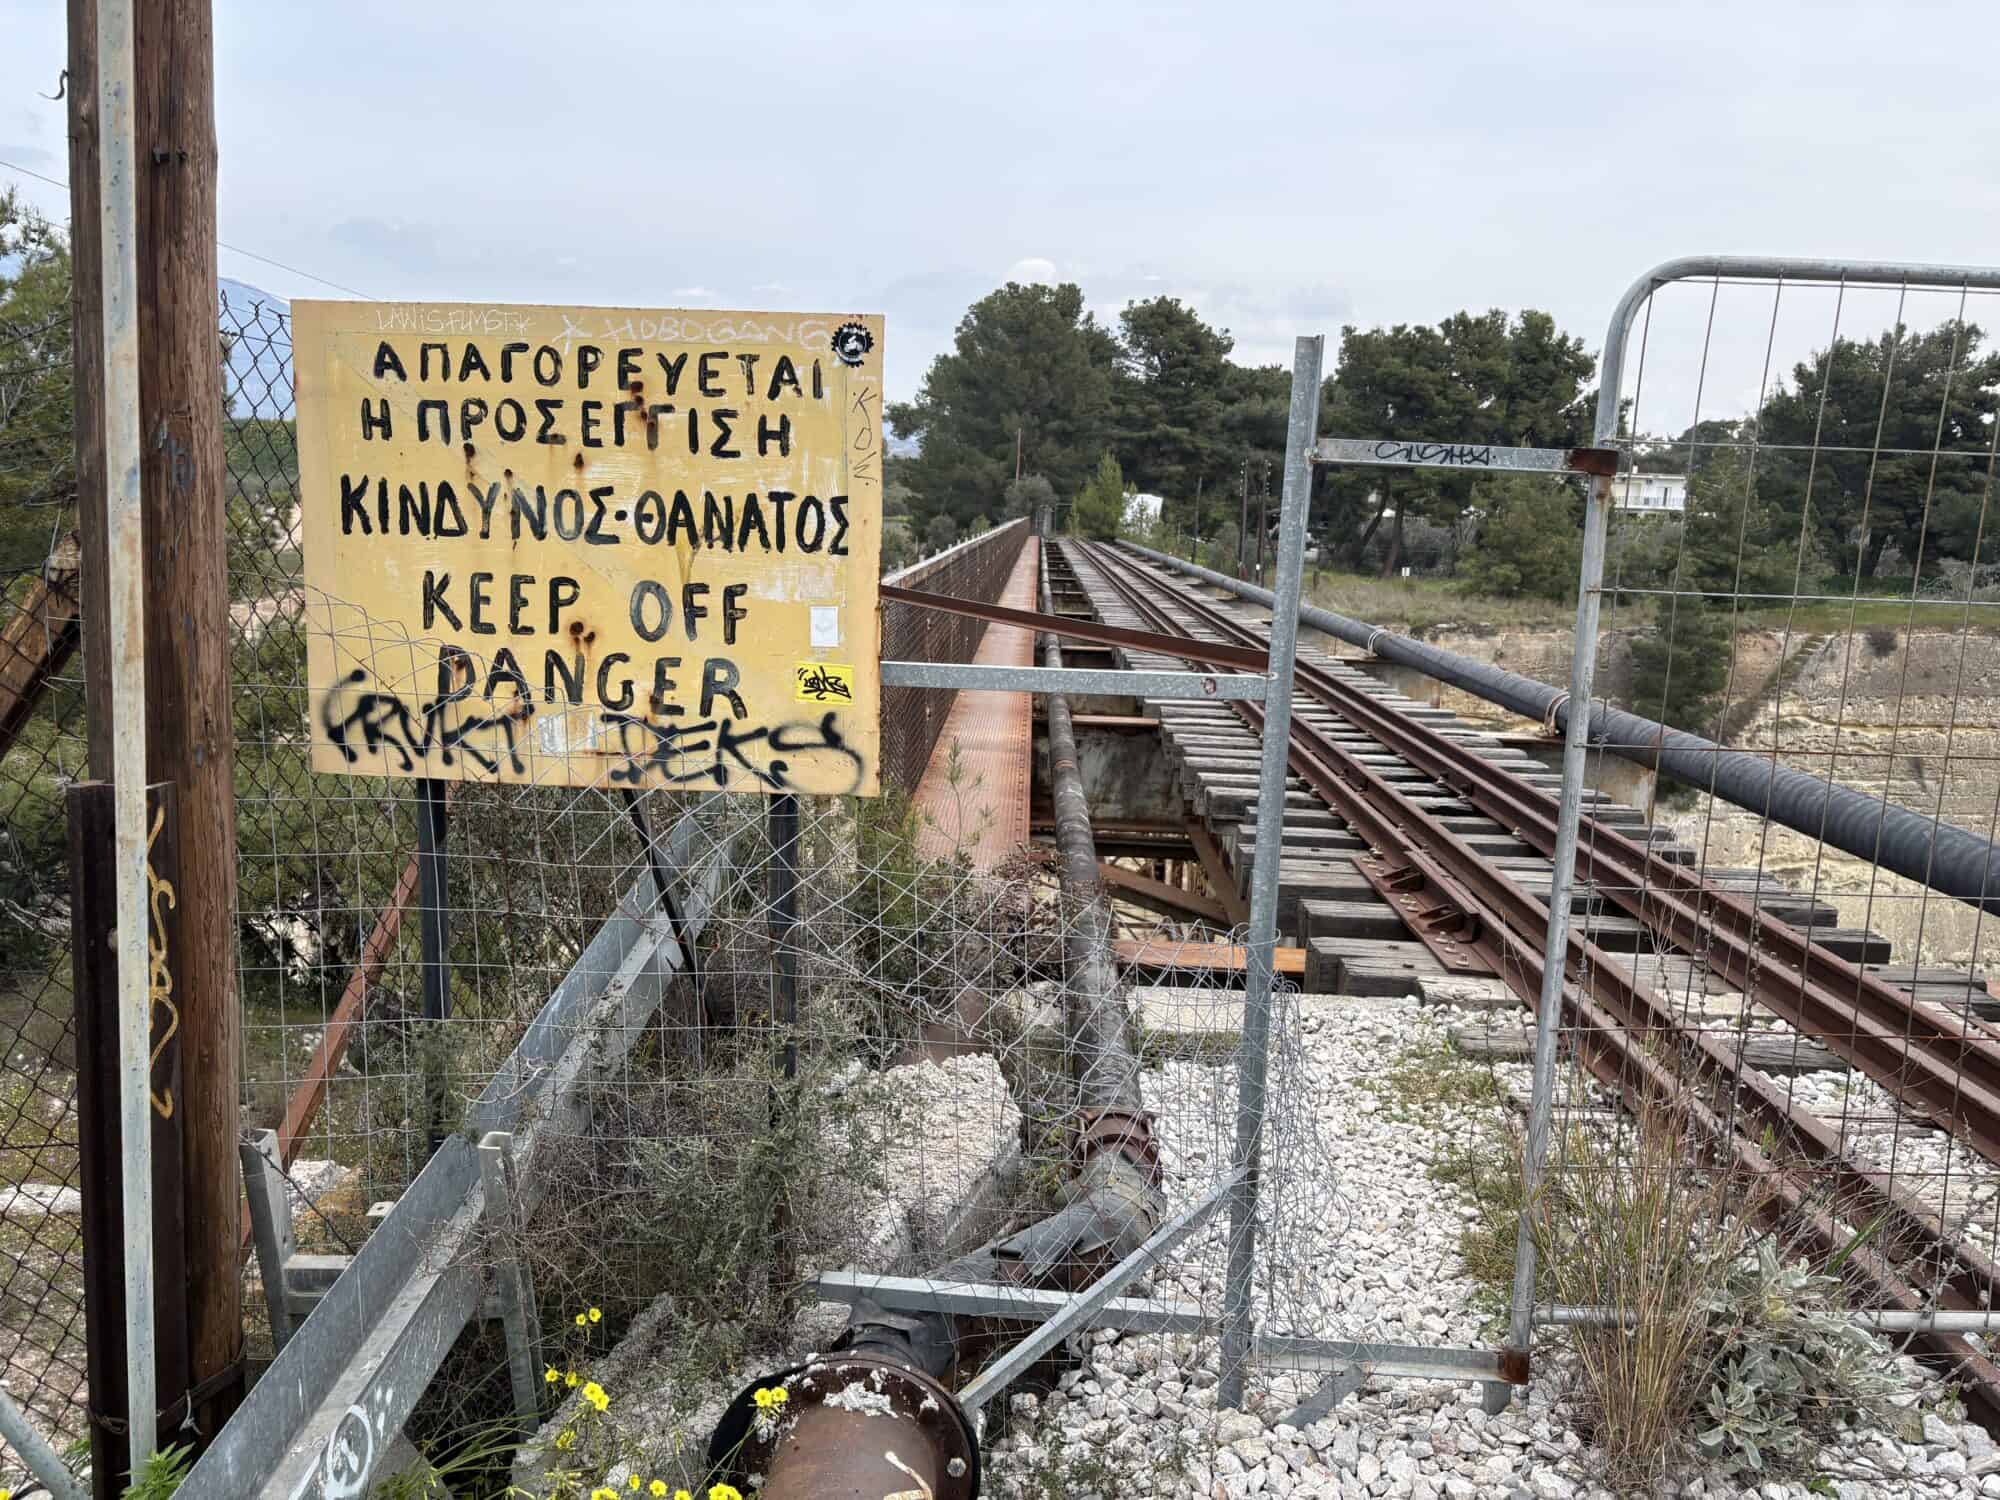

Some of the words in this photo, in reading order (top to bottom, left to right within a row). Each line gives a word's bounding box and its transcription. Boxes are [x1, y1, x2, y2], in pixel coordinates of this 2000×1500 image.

[373, 341, 823, 400] ΑΠΑΓΟΡΕΥΕΤΑΙ
[361, 398, 392, 440] Η
[417, 398, 791, 458] ΠΡΟΣΕΓΓΙΣΗ
[422, 570, 581, 635] KEEP
[629, 580, 748, 645] OFF
[438, 644, 748, 719] DANGER
